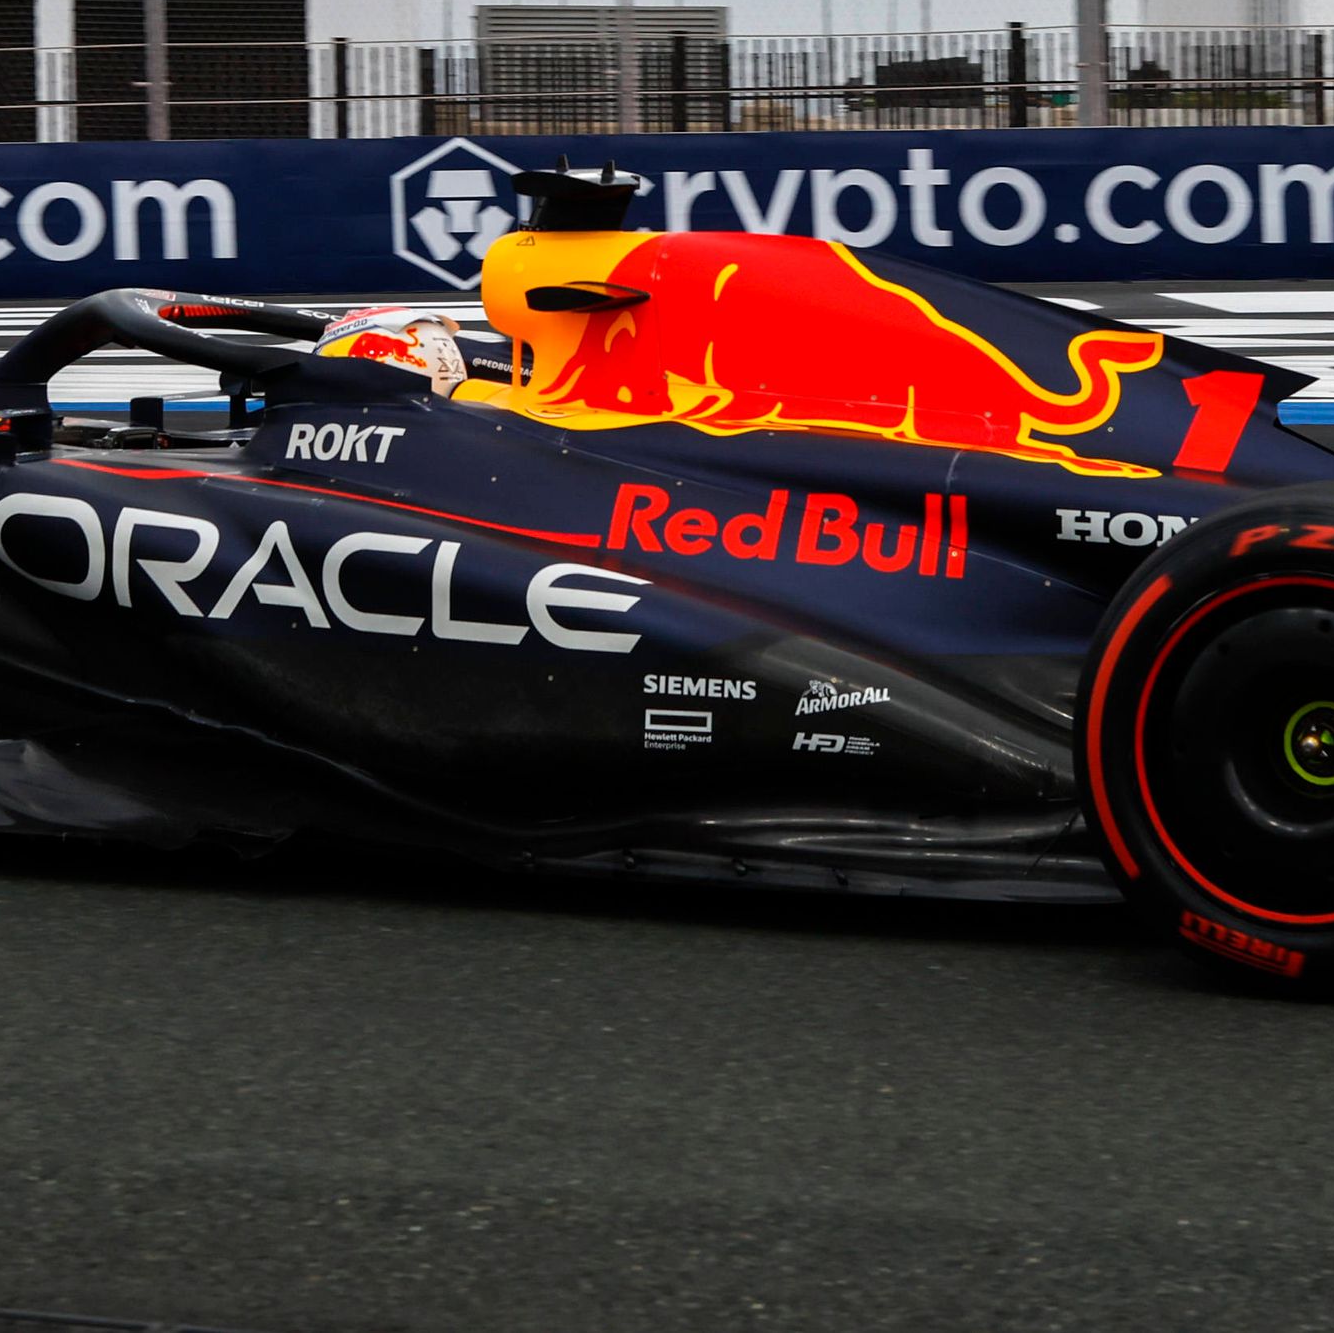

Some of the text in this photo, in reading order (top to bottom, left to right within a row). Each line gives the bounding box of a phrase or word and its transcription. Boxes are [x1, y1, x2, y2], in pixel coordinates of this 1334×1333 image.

[1172, 370, 1265, 473] 1
[285, 423, 406, 464] ROKT
[606, 483, 970, 580] Red Bull
[1228, 524, 1281, 558] P
[643, 675, 757, 700] SIEMENS
[644, 732, 713, 744] Hewlett Packard
